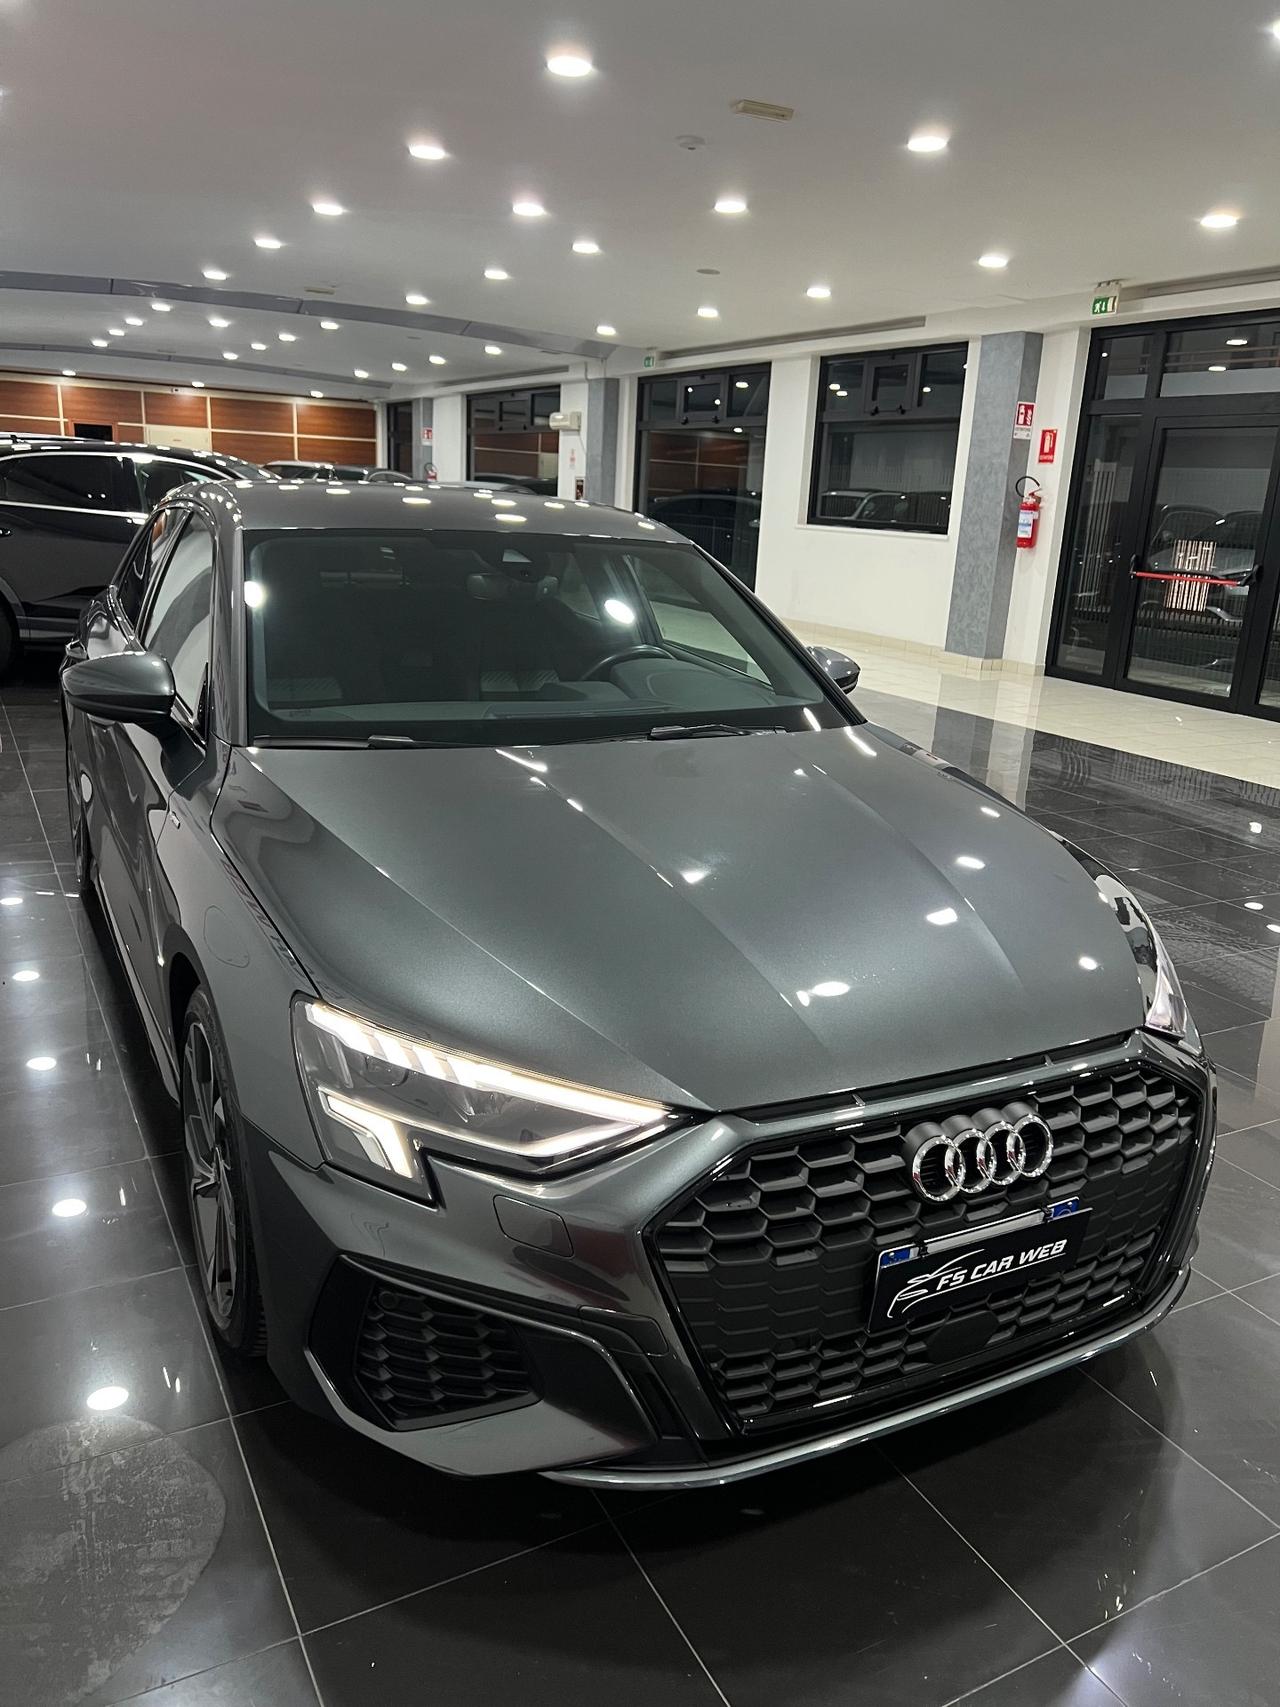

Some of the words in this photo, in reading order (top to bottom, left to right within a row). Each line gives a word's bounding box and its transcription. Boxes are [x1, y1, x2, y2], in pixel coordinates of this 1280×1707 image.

[936, 1269, 967, 1290] FS
[970, 1255, 1014, 1280] CAR
[1019, 1239, 1067, 1264] WEB
